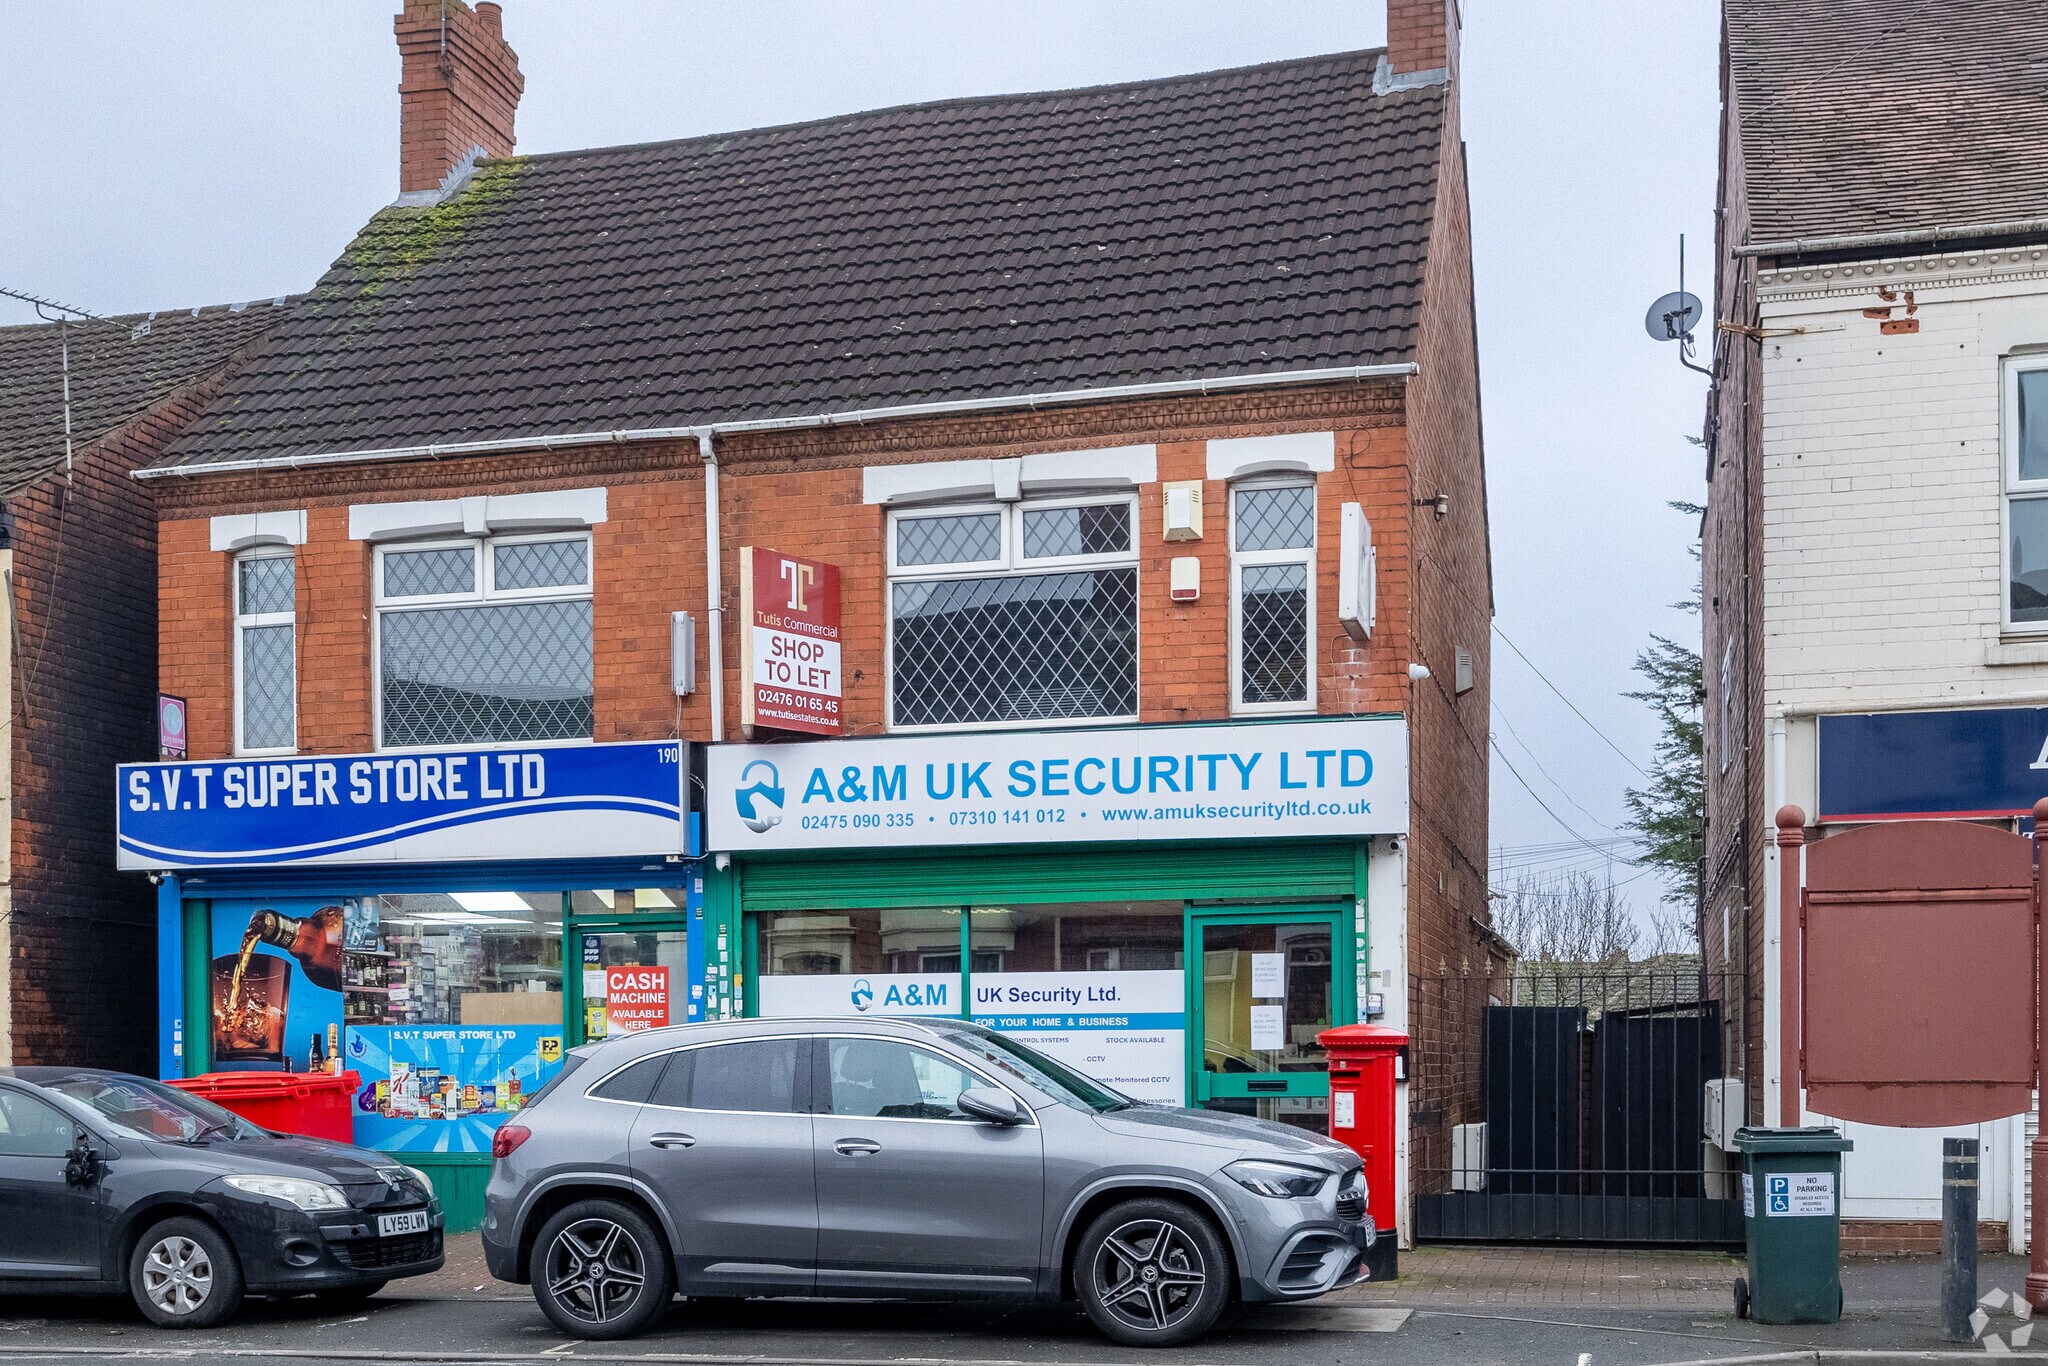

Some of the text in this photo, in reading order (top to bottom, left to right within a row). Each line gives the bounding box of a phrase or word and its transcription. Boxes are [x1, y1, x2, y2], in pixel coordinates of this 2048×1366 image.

[757, 610, 838, 638] Tutis Commercial
[771, 635, 824, 663] SHOP
[764, 659, 831, 690] TO LET
[758, 689, 838, 713] 02476 01 65 45
[758, 707, 839, 727] www.tutisestates.co.uk
[657, 747, 678, 764] 190
[129, 753, 546, 812] S.V.T SUPER STORE LTD
[801, 749, 1374, 804] A&M UK SECURITY LTD
[801, 798, 1372, 830] 02475 090 335 07310 141 012 www.amuksecurityltd.co.uk
[609, 972, 666, 991] CASH
[610, 992, 666, 1004] MACHINE
[883, 983, 1121, 1006] A&M UK Security Ltd.
[612, 1009, 664, 1019] AVAILABLE
[975, 1017, 1129, 1027] FOR YOUR HOME & BUSINESS
[625, 1020, 651, 1029] HERE
[393, 1030, 516, 1040] S.V.T SUPER STORE LTD
[1129, 1036, 1165, 1044] AVAILABLE
[1796, 1185, 1828, 1193] PARKING
[383, 1215, 410, 1234] LY59
